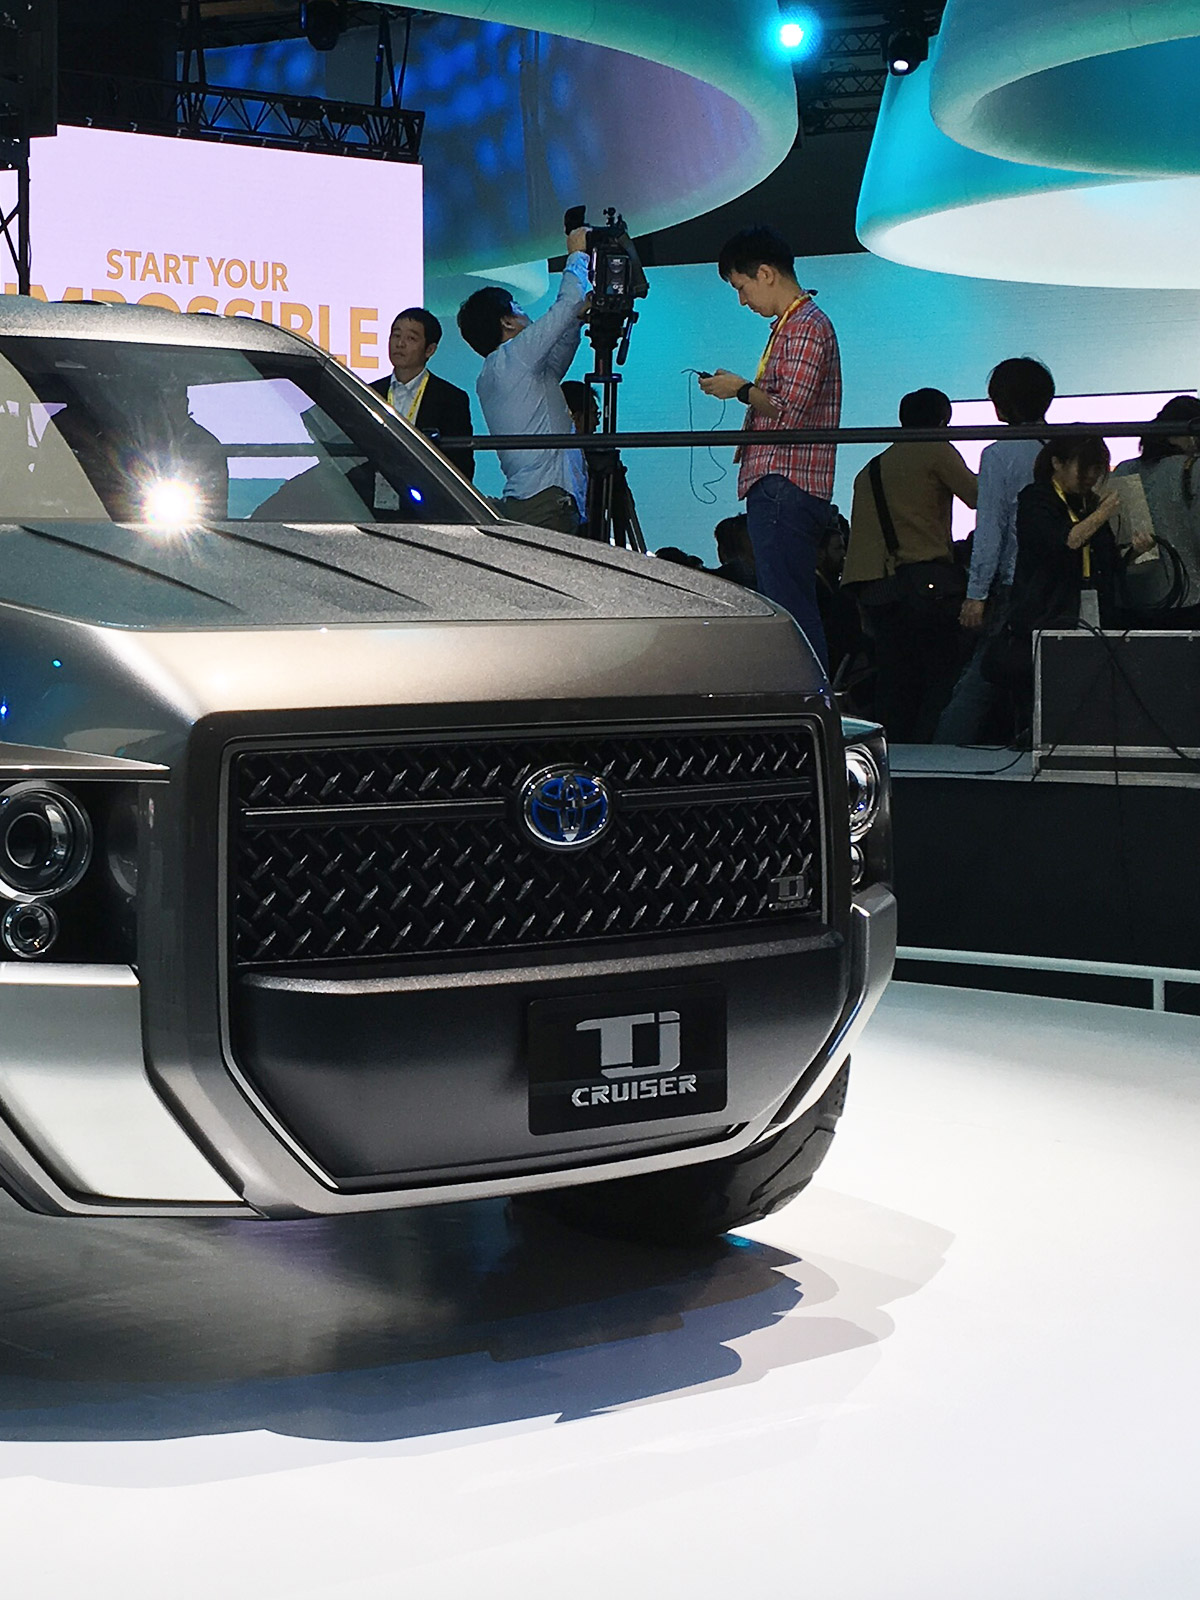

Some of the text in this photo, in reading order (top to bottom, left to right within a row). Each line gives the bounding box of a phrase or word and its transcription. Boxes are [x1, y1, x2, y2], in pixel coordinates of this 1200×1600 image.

[106, 248, 289, 292] START YOUR
[571, 1074, 697, 1107] CRUISER
